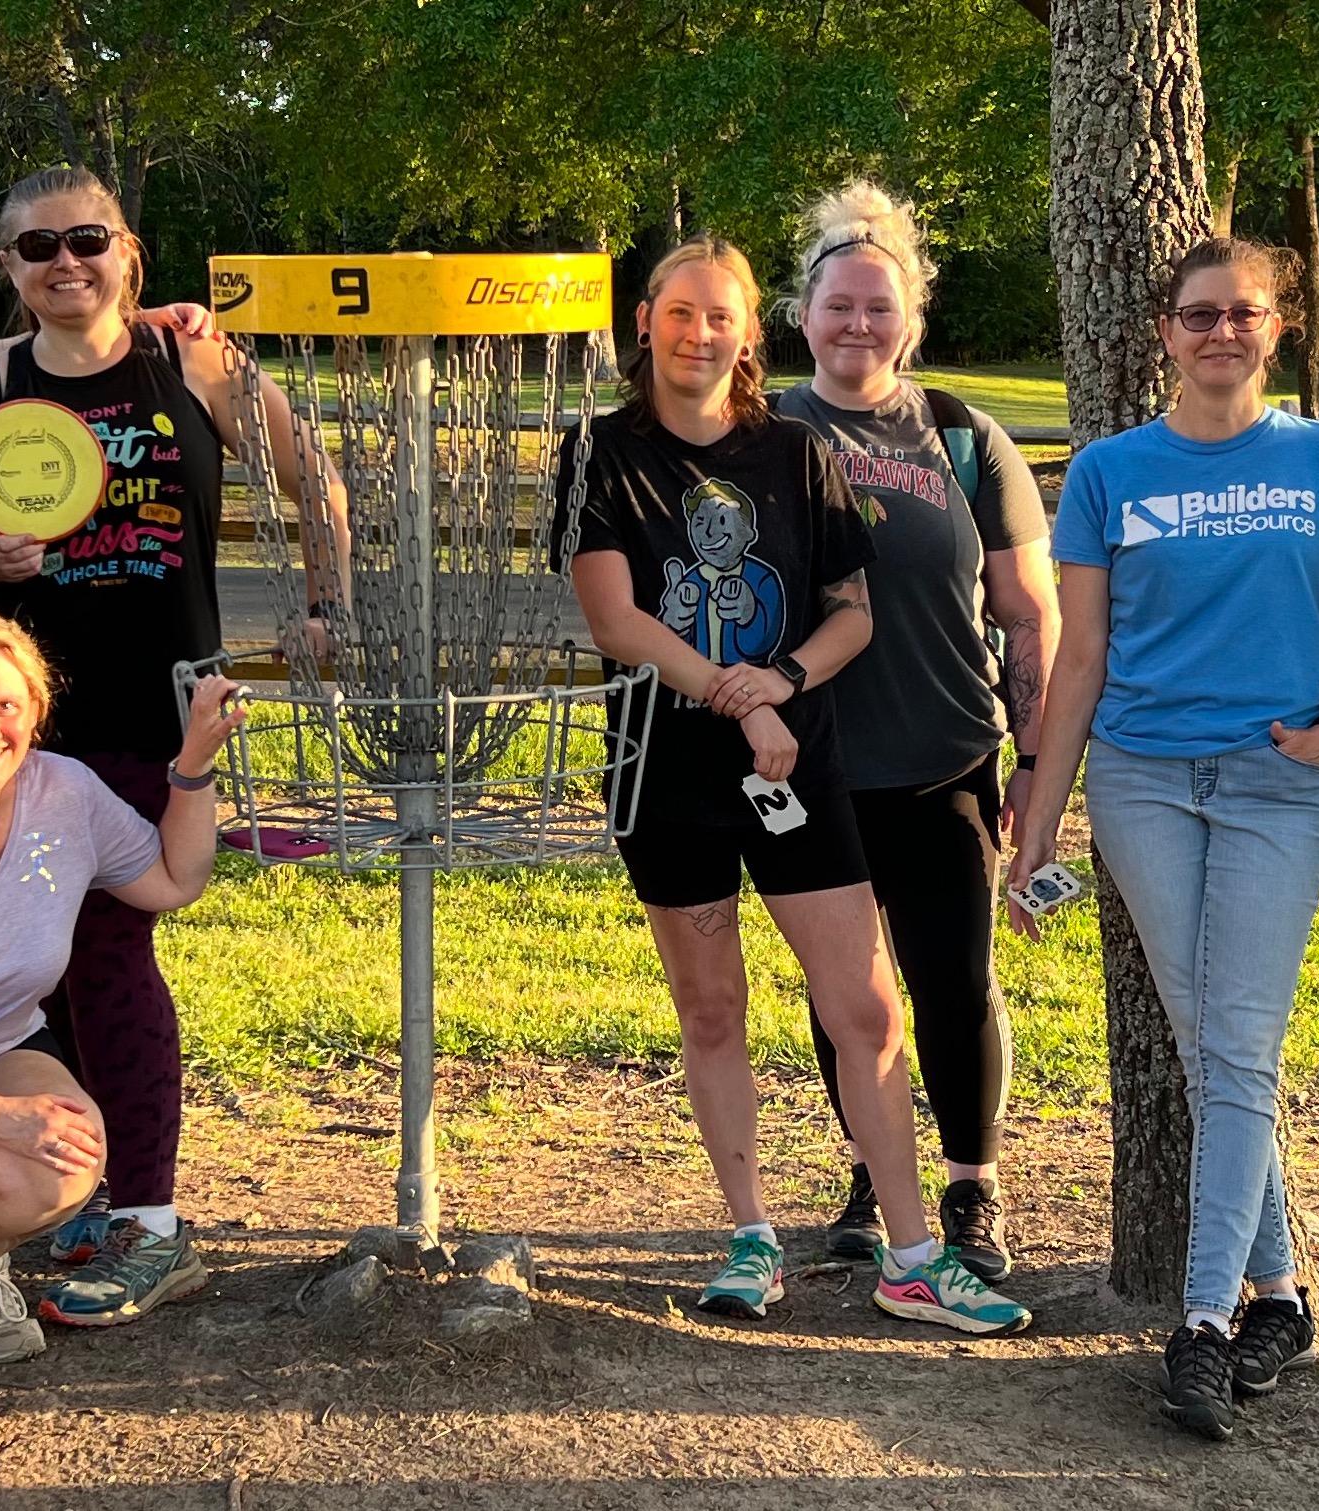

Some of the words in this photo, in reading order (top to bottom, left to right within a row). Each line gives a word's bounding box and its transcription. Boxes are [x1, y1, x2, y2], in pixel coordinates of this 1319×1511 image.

[213, 272, 246, 288] NOVA
[331, 268, 369, 315] 9
[152, 445, 181, 461] but
[833, 451, 948, 511] KHAWKS
[1182, 483, 1316, 518] Builders
[1182, 514, 1316, 538] FirstSource
[60, 522, 184, 558] uss
[139, 536, 162, 551] the
[54, 560, 119, 585] WHOLE
[125, 560, 166, 580] TIME
